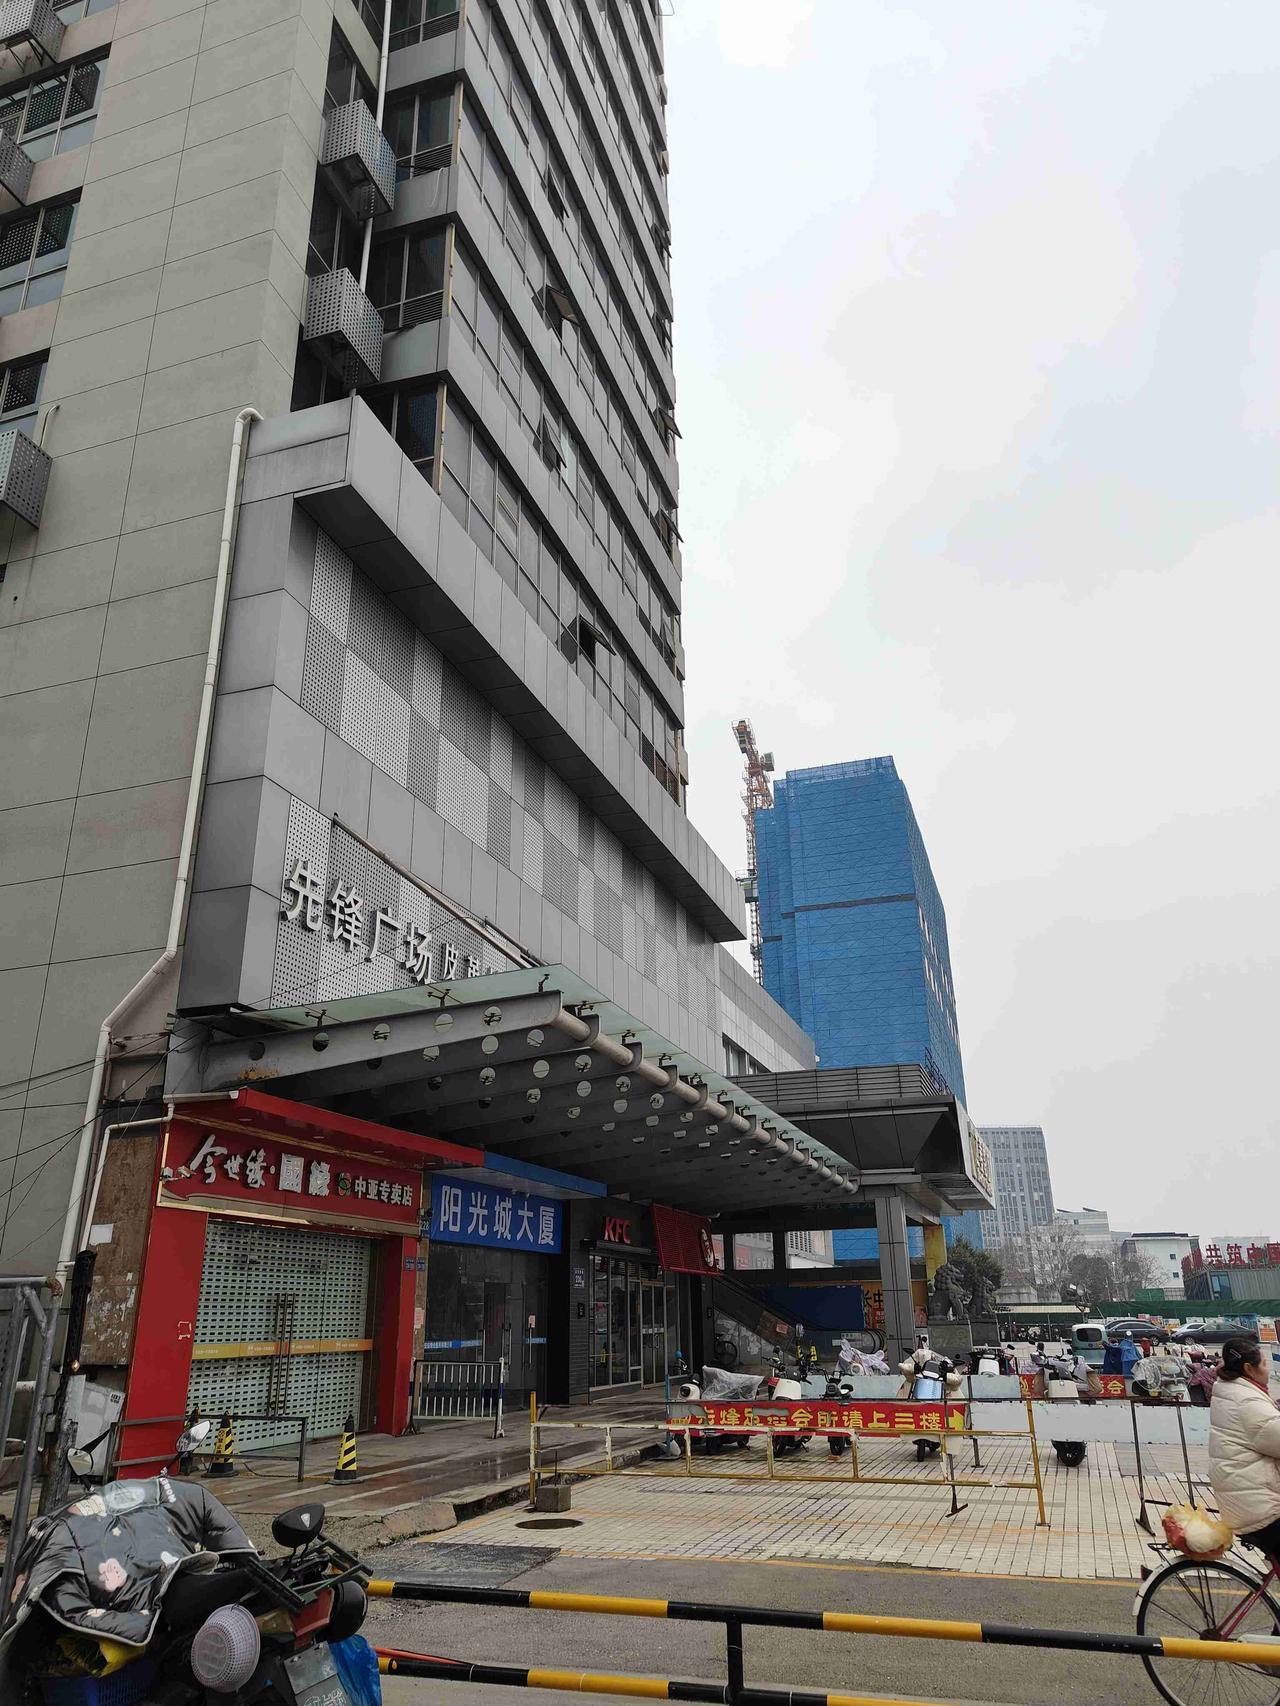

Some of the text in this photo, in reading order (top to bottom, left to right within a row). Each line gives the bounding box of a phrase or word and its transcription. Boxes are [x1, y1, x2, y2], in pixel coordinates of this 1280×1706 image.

[354, 1175, 413, 1207] 中亚专卖店
[439, 1184, 556, 1247] 阳光城大厦
[604, 1216, 631, 1244] KFC
